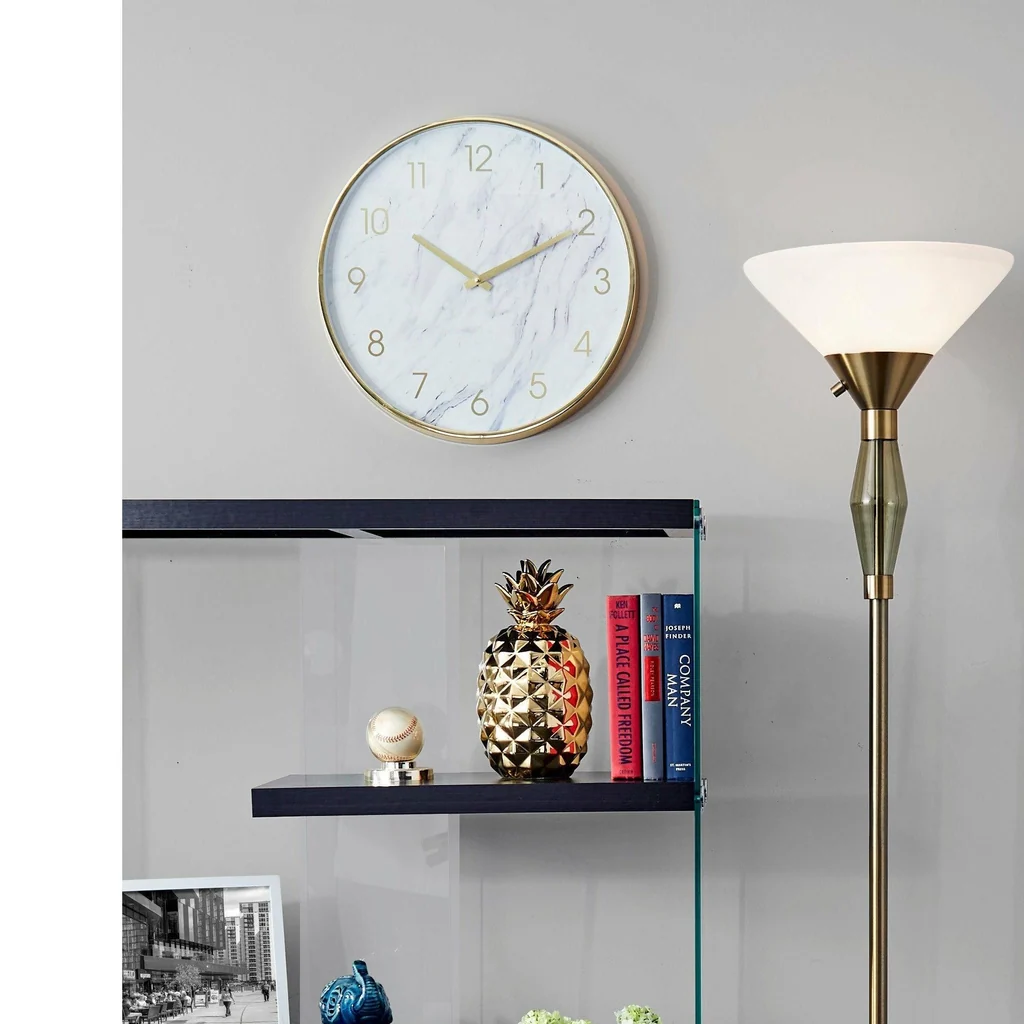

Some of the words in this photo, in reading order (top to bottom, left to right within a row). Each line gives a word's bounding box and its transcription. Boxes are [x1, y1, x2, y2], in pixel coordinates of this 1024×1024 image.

[464, 144, 493, 172] 12
[407, 162, 426, 189] 11
[535, 162, 545, 190] 1
[360, 207, 390, 235] 10
[577, 208, 596, 236] 2
[347, 266, 366, 294] 9
[593, 267, 611, 295] 3
[367, 329, 385, 357] 8
[573, 330, 593, 358] 4
[412, 372, 428, 399] 7
[528, 372, 548, 400] 5
[470, 389, 489, 416] 6
[609, 610, 635, 620] FOLLETT
[616, 600, 628, 609] KEN
[615, 624, 629, 632] A
[616, 635, 630, 669] PLACE
[616, 671, 632, 711] CALLED
[666, 673, 679, 707] MAN
[679, 654, 692, 727] COMPANY
[617, 714, 633, 765] FREEDOM
